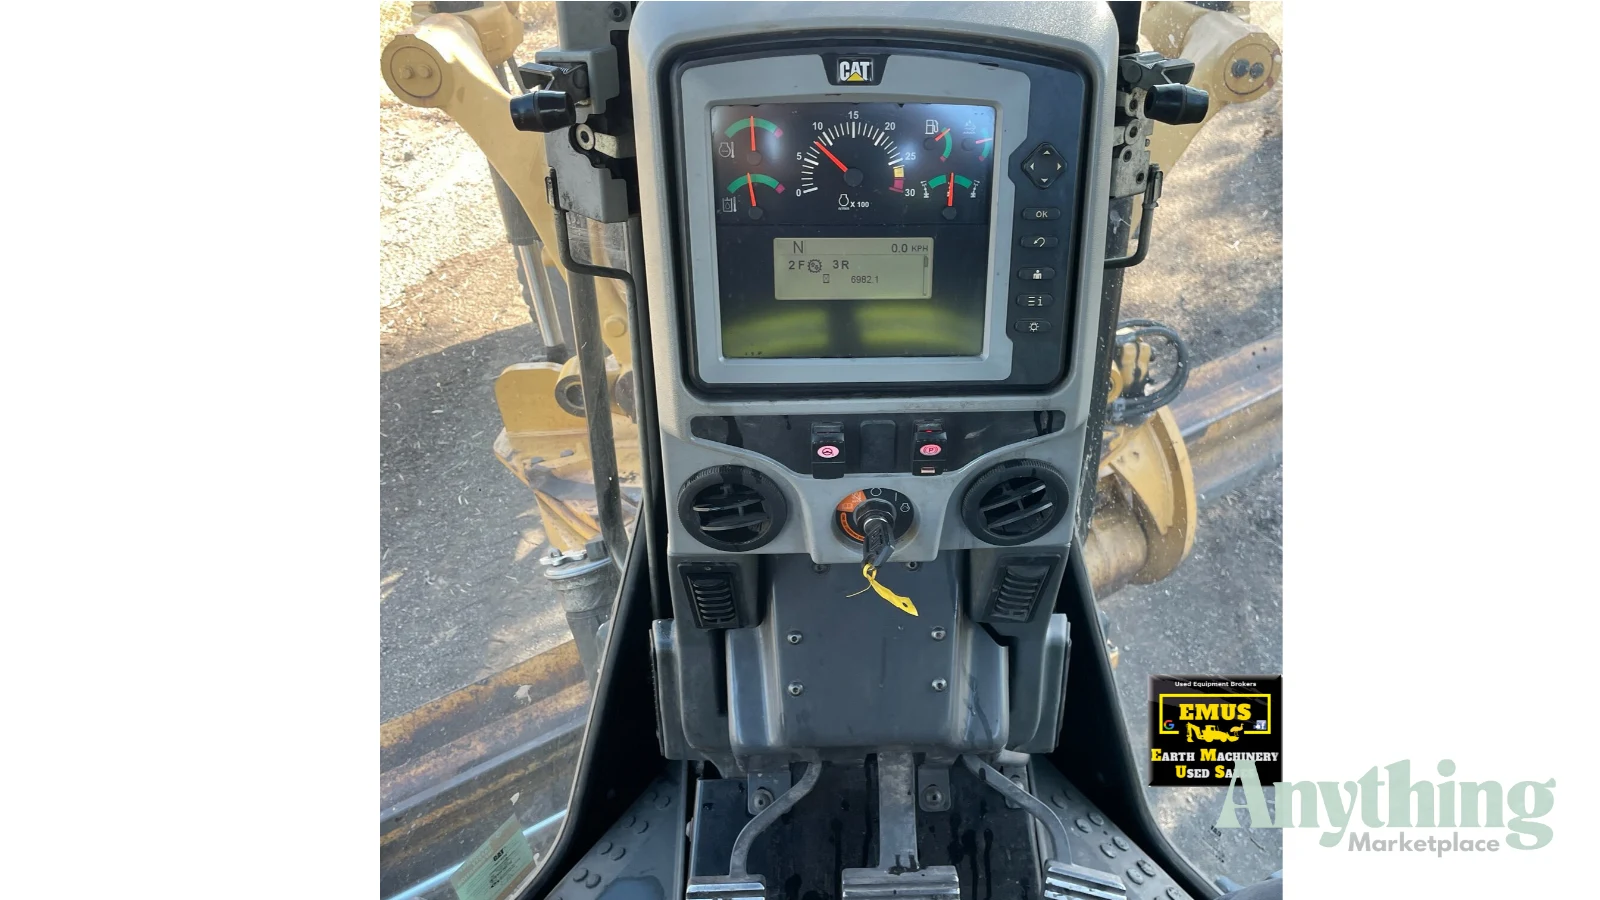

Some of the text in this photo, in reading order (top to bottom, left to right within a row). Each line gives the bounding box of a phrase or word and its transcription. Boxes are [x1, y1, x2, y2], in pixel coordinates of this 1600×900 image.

[839, 61, 870, 82] CAT
[848, 111, 859, 120] 15
[812, 122, 823, 131] 10
[884, 122, 896, 131] 20
[796, 152, 802, 160] 5
[905, 152, 916, 161] 25
[796, 189, 801, 197] 0
[905, 188, 916, 197] 30
[1035, 210, 1048, 218] OK
[793, 241, 804, 254] N
[891, 243, 929, 253] 0.0 KPH
[788, 260, 805, 270] 2 F
[832, 260, 850, 270] 3 R
[850, 275, 879, 284] 6982.1
